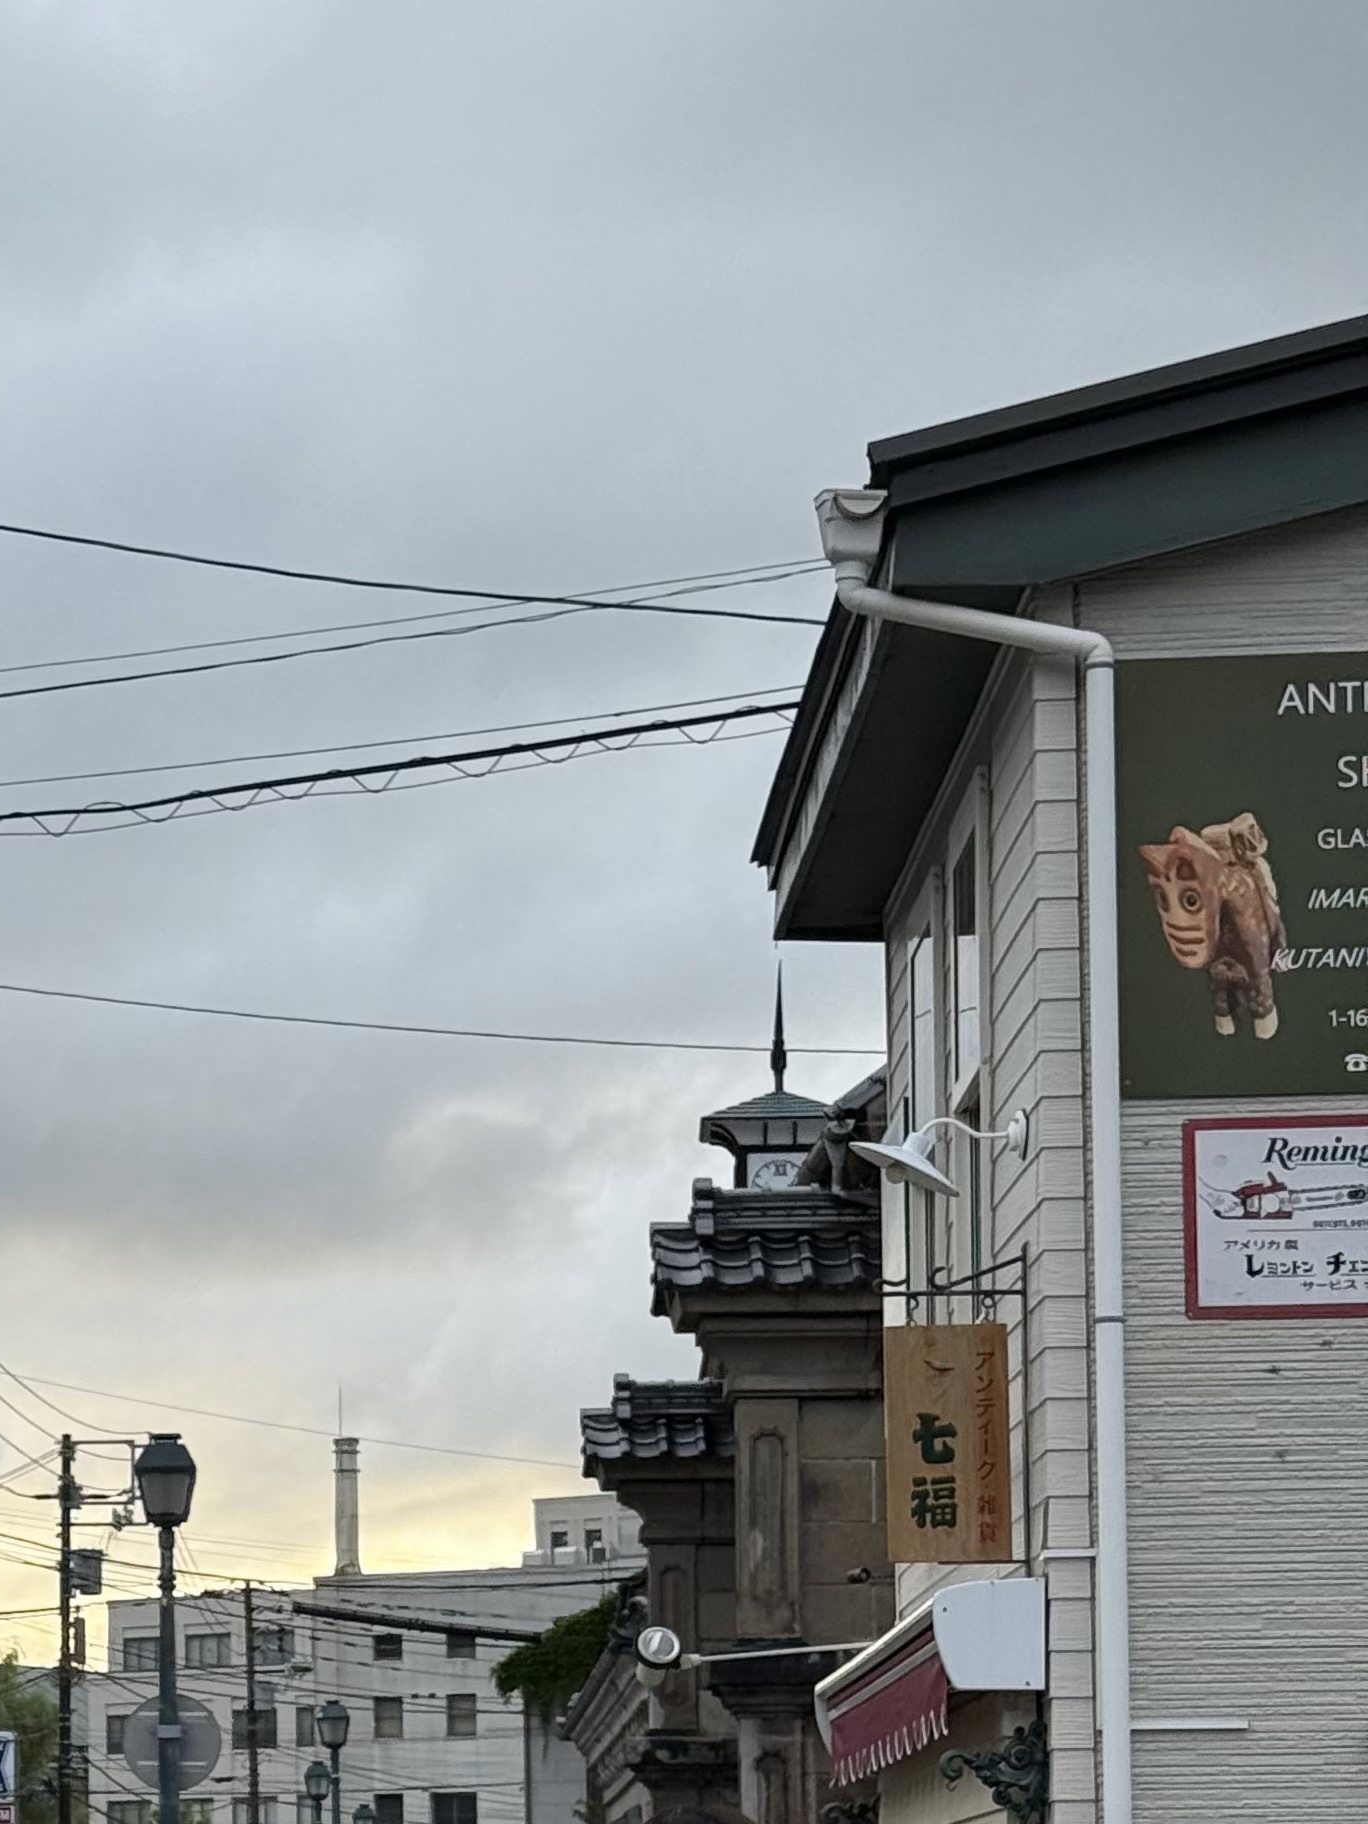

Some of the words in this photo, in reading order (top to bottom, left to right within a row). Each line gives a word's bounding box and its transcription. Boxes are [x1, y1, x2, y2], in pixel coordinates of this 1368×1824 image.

[1317, 827, 1368, 850] GLA
[1271, 947, 1368, 971] KUTANI
[911, 1412, 958, 1529] 七福
